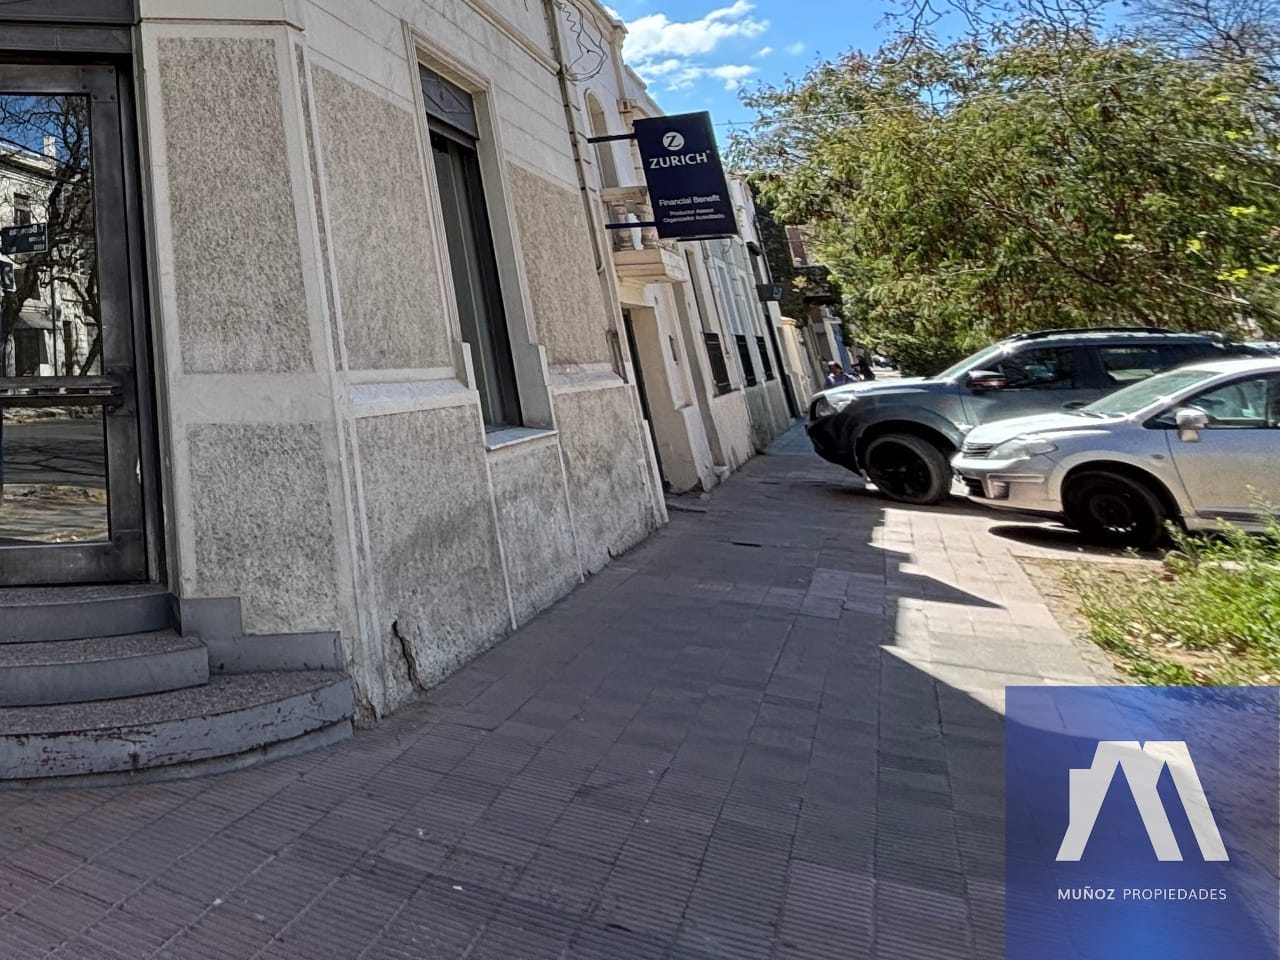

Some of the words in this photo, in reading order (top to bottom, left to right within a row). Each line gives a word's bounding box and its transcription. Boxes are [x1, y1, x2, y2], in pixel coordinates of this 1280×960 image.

[649, 152, 708, 169] ZURICH
[658, 196, 692, 207] Financial
[693, 194, 721, 204] Benefit
